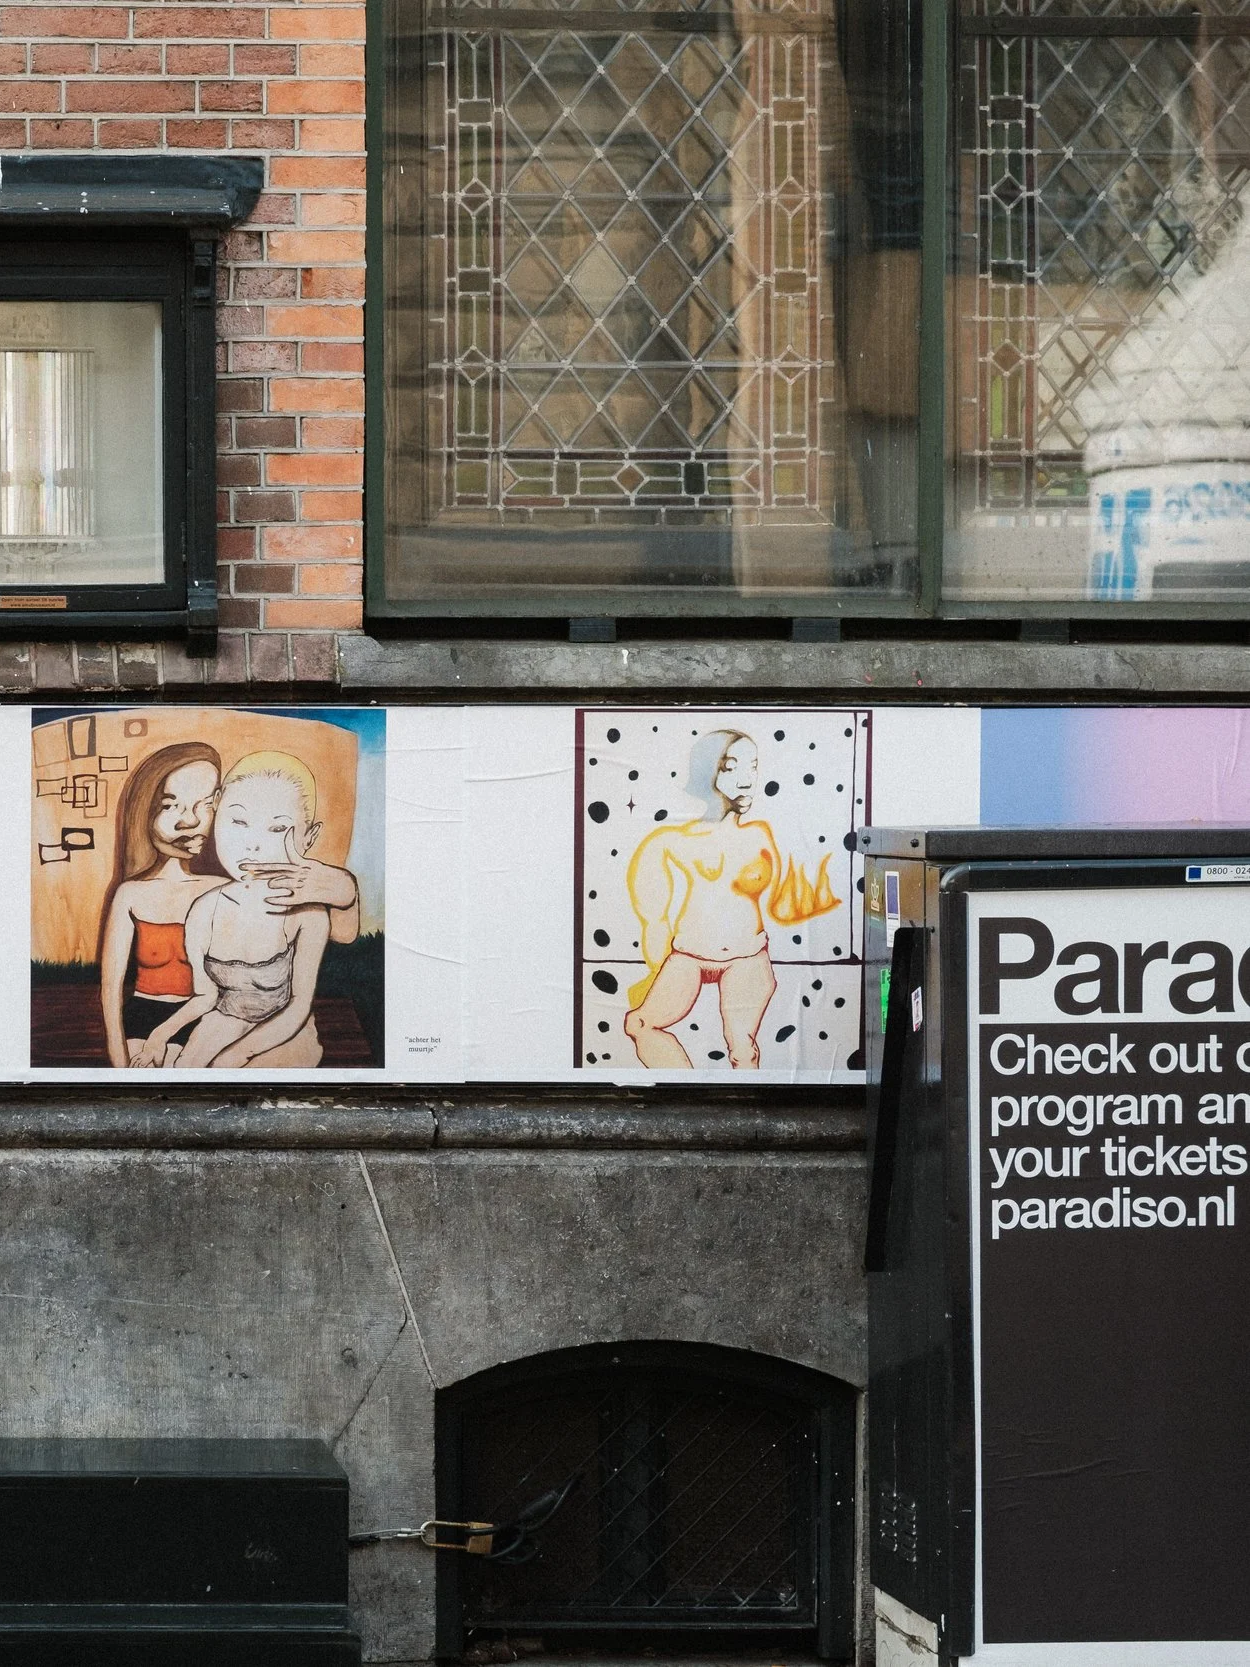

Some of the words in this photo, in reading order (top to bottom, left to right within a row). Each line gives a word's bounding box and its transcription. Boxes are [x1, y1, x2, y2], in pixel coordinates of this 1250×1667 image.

[1206, 867, 1228, 875] 0800
[979, 917, 1250, 1016] Para
[990, 1033, 1137, 1076] Check
[1149, 1034, 1223, 1074] out
[991, 1093, 1183, 1137] program
[989, 1145, 1090, 1189] your
[1100, 1135, 1249, 1177] tickets
[991, 1185, 1236, 1240] paradiso.nl
